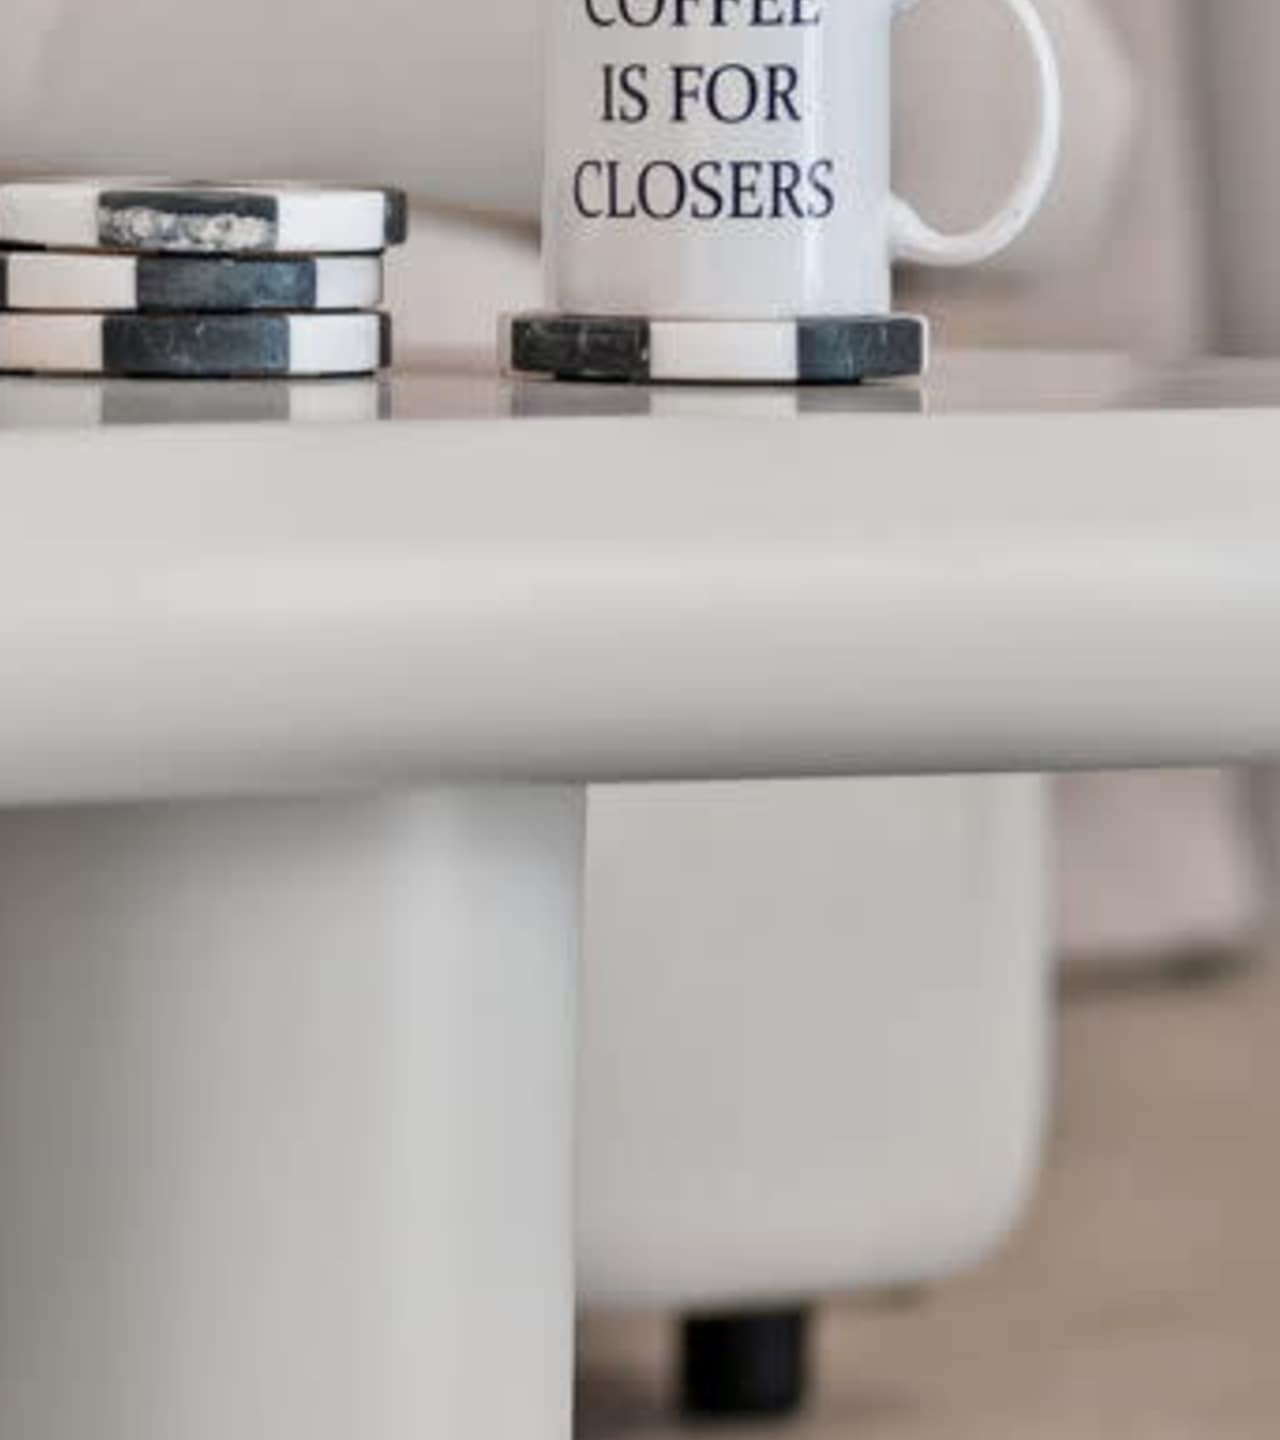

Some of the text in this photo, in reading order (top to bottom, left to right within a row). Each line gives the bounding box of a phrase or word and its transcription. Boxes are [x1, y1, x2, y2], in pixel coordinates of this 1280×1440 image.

[600, 63, 802, 123] IS FOR
[573, 159, 836, 220] CLOSERS
